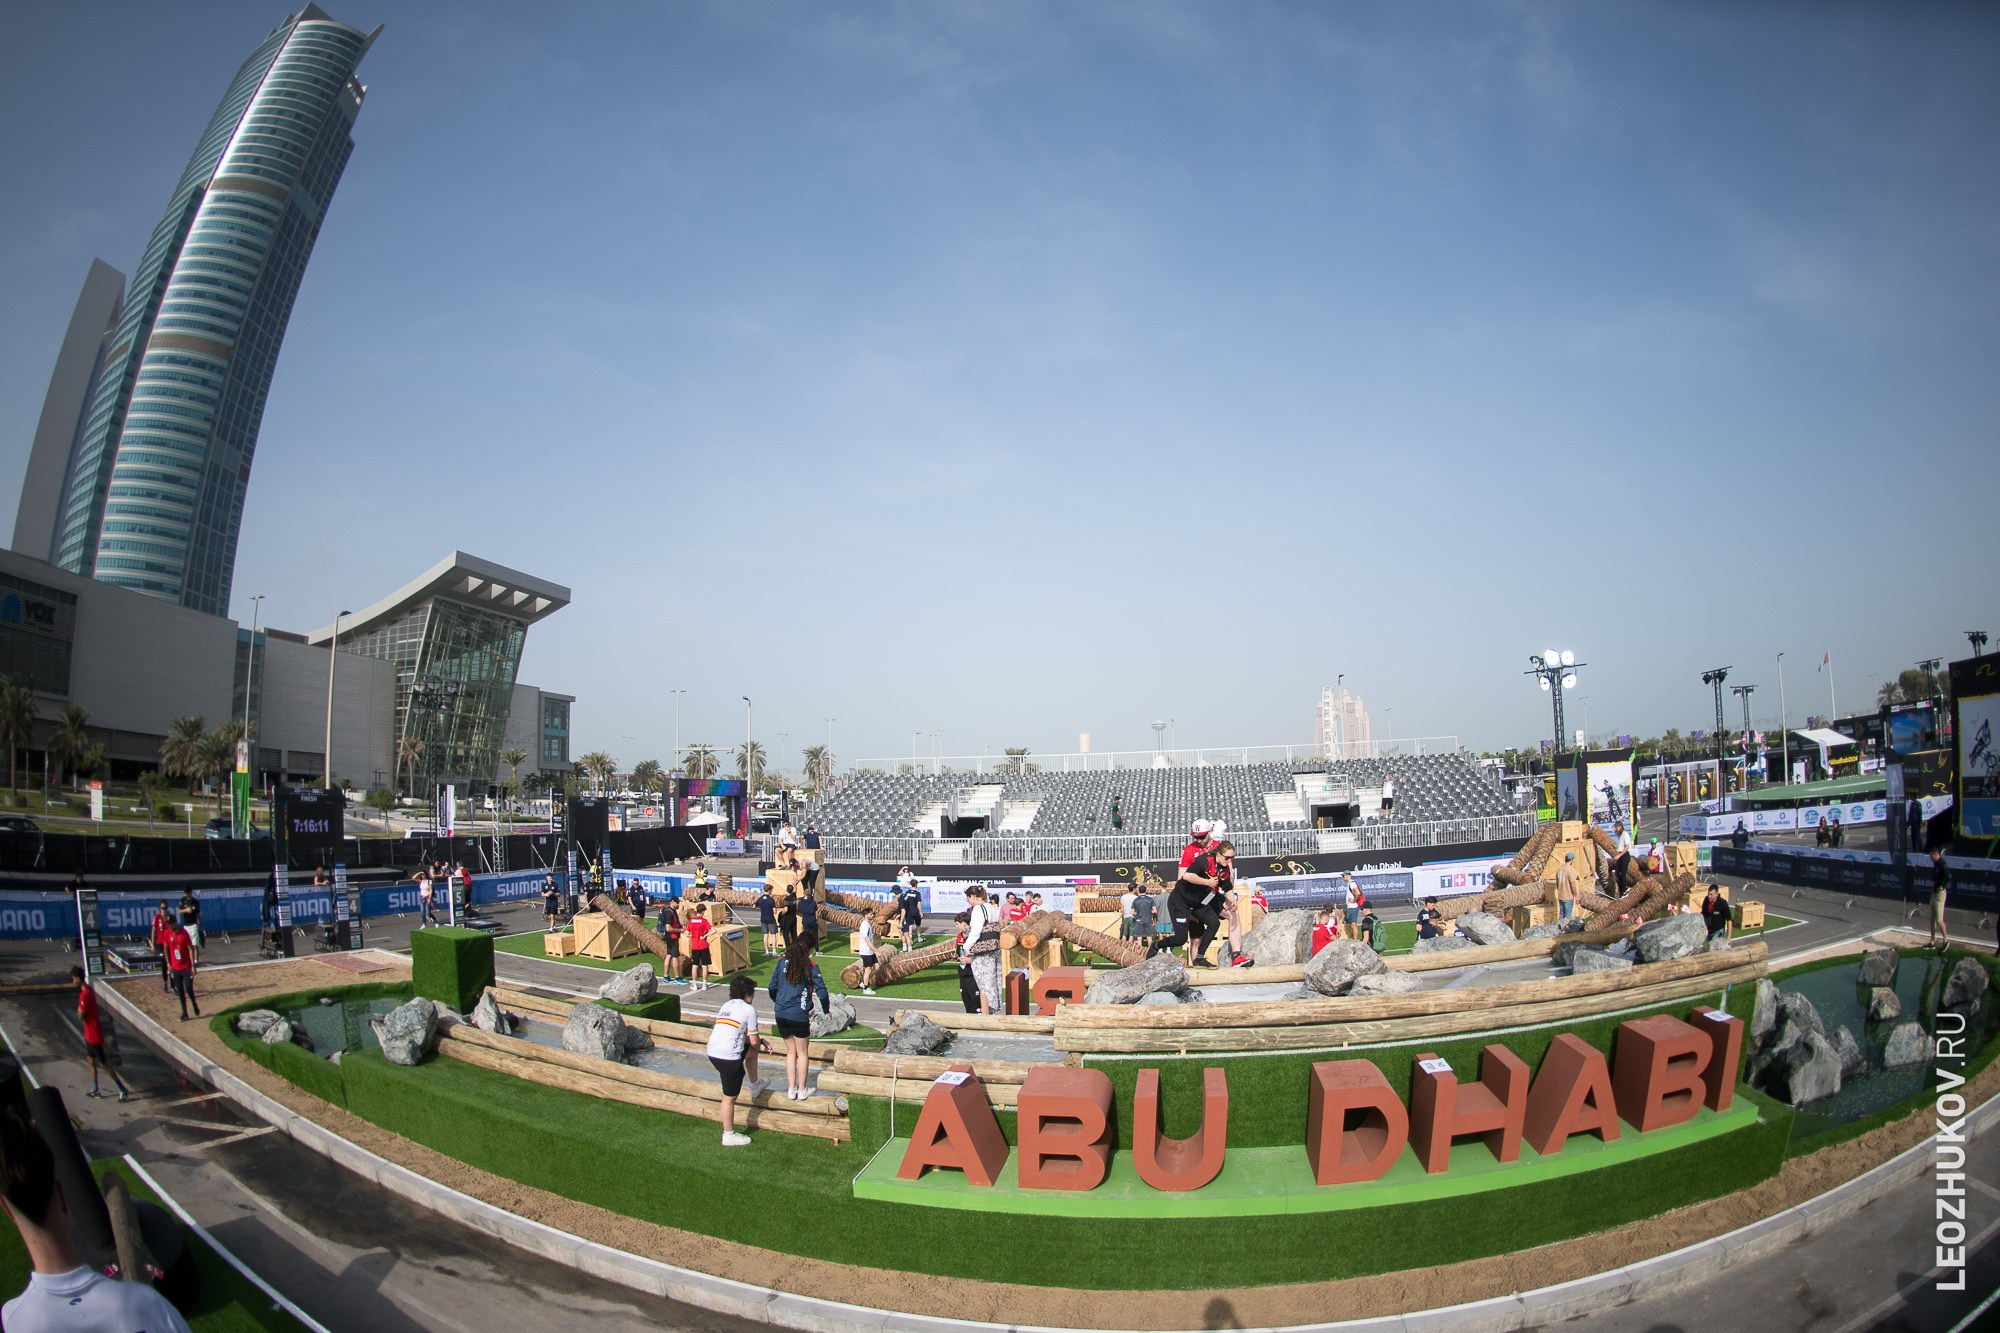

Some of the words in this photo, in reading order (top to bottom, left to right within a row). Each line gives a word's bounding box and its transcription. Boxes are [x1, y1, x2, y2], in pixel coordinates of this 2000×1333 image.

[294, 819, 329, 832] 7:16:11
[1380, 861, 1402, 869] Dhabi
[1468, 872, 1494, 886] TIS
[497, 879, 546, 897] SHIMAN
[456, 891, 462, 903] 5
[350, 900, 357, 912] 4
[86, 911, 95, 928] 4
[139, 963, 154, 971] UCI
[897, 1065, 1229, 1192] ABU
[1306, 1006, 1743, 1186] DHABI
